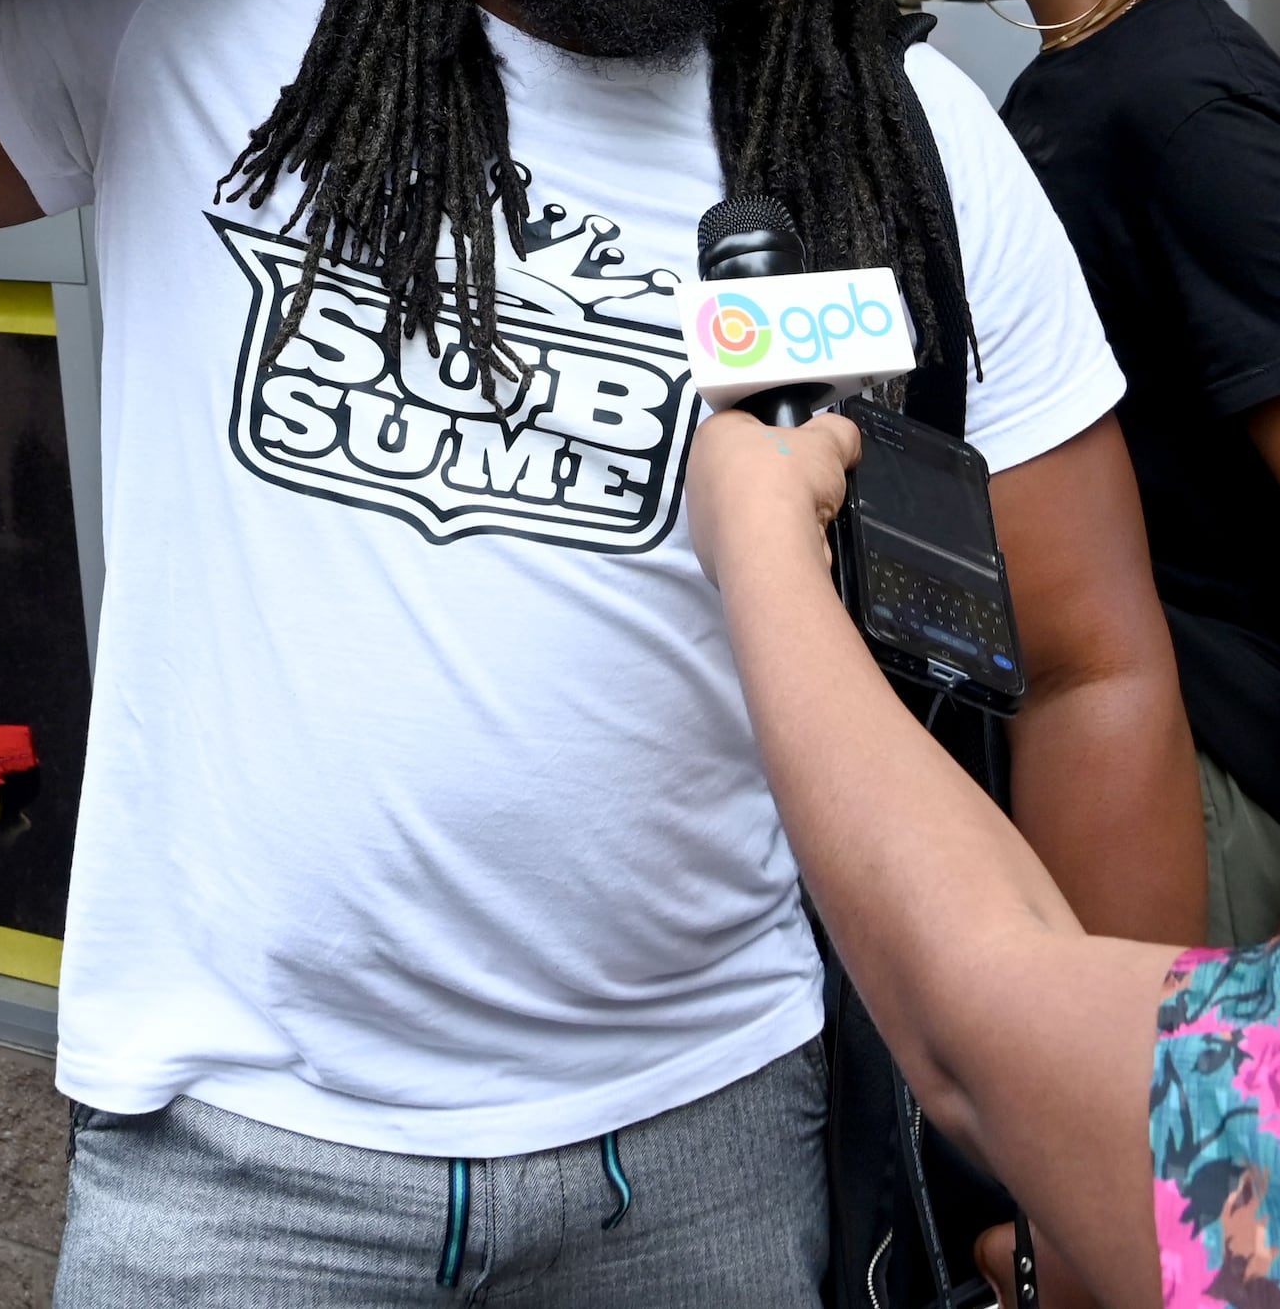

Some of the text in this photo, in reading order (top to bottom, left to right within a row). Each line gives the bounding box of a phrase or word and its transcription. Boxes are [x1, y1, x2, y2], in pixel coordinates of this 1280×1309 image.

[276, 291, 670, 451] SUB
[779, 283, 893, 365] gpb
[260, 368, 652, 517] SUME
